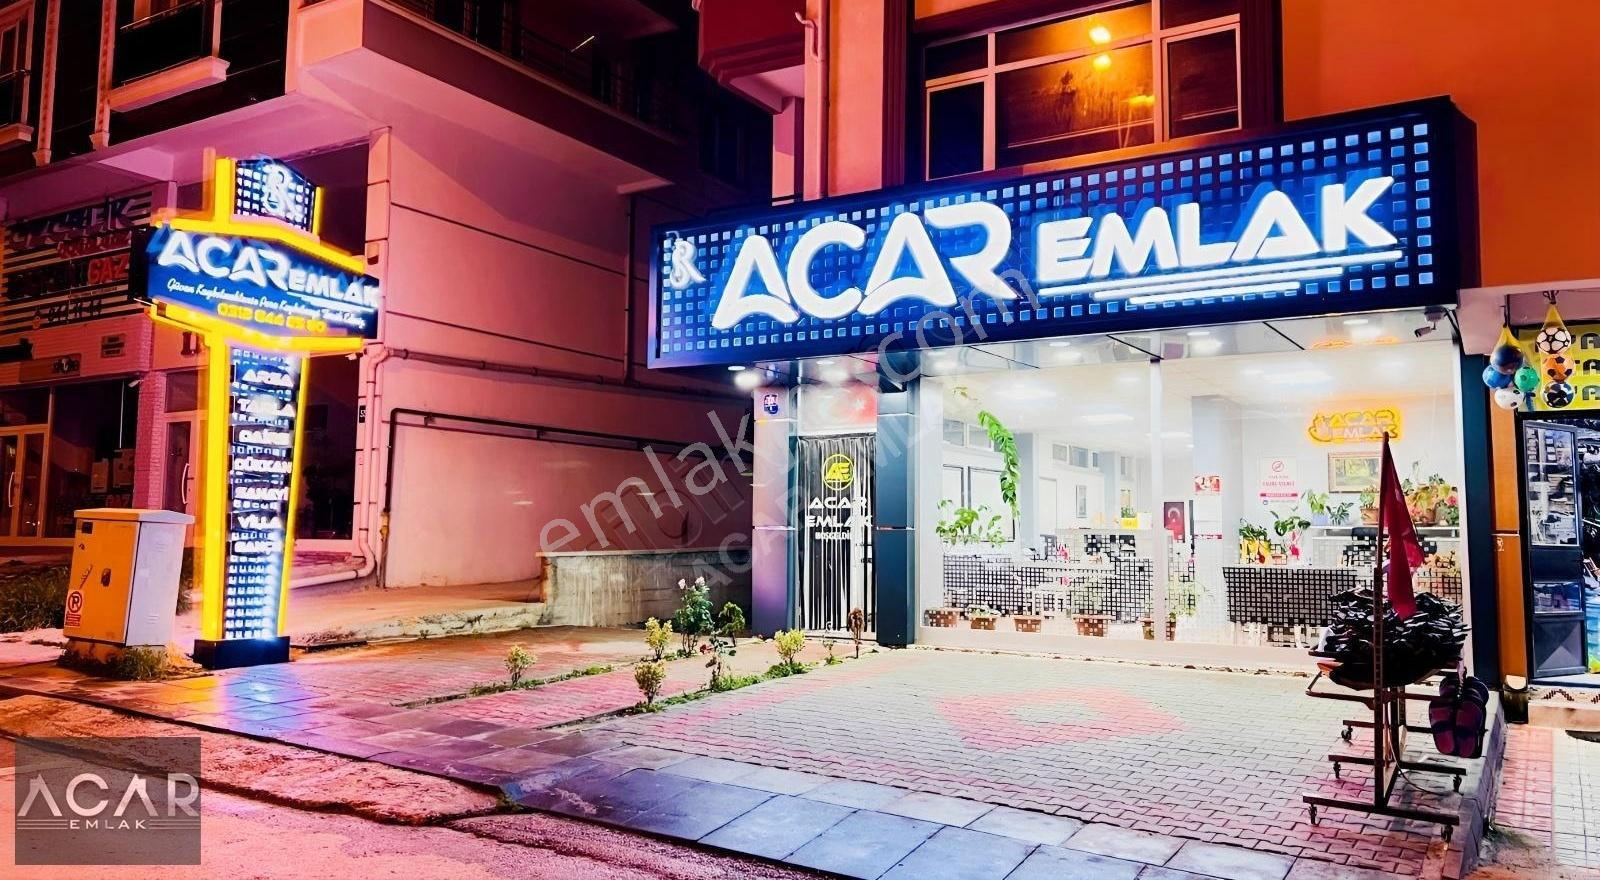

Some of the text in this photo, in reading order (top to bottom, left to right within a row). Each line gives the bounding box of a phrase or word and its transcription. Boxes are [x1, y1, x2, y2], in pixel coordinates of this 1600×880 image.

[157, 230, 288, 291] ACAR
[288, 268, 379, 307] EMLAK
[712, 174, 1397, 329] ACAR EMLAK
[806, 515, 873, 528] EMLAK
[809, 496, 868, 509] ACAR
